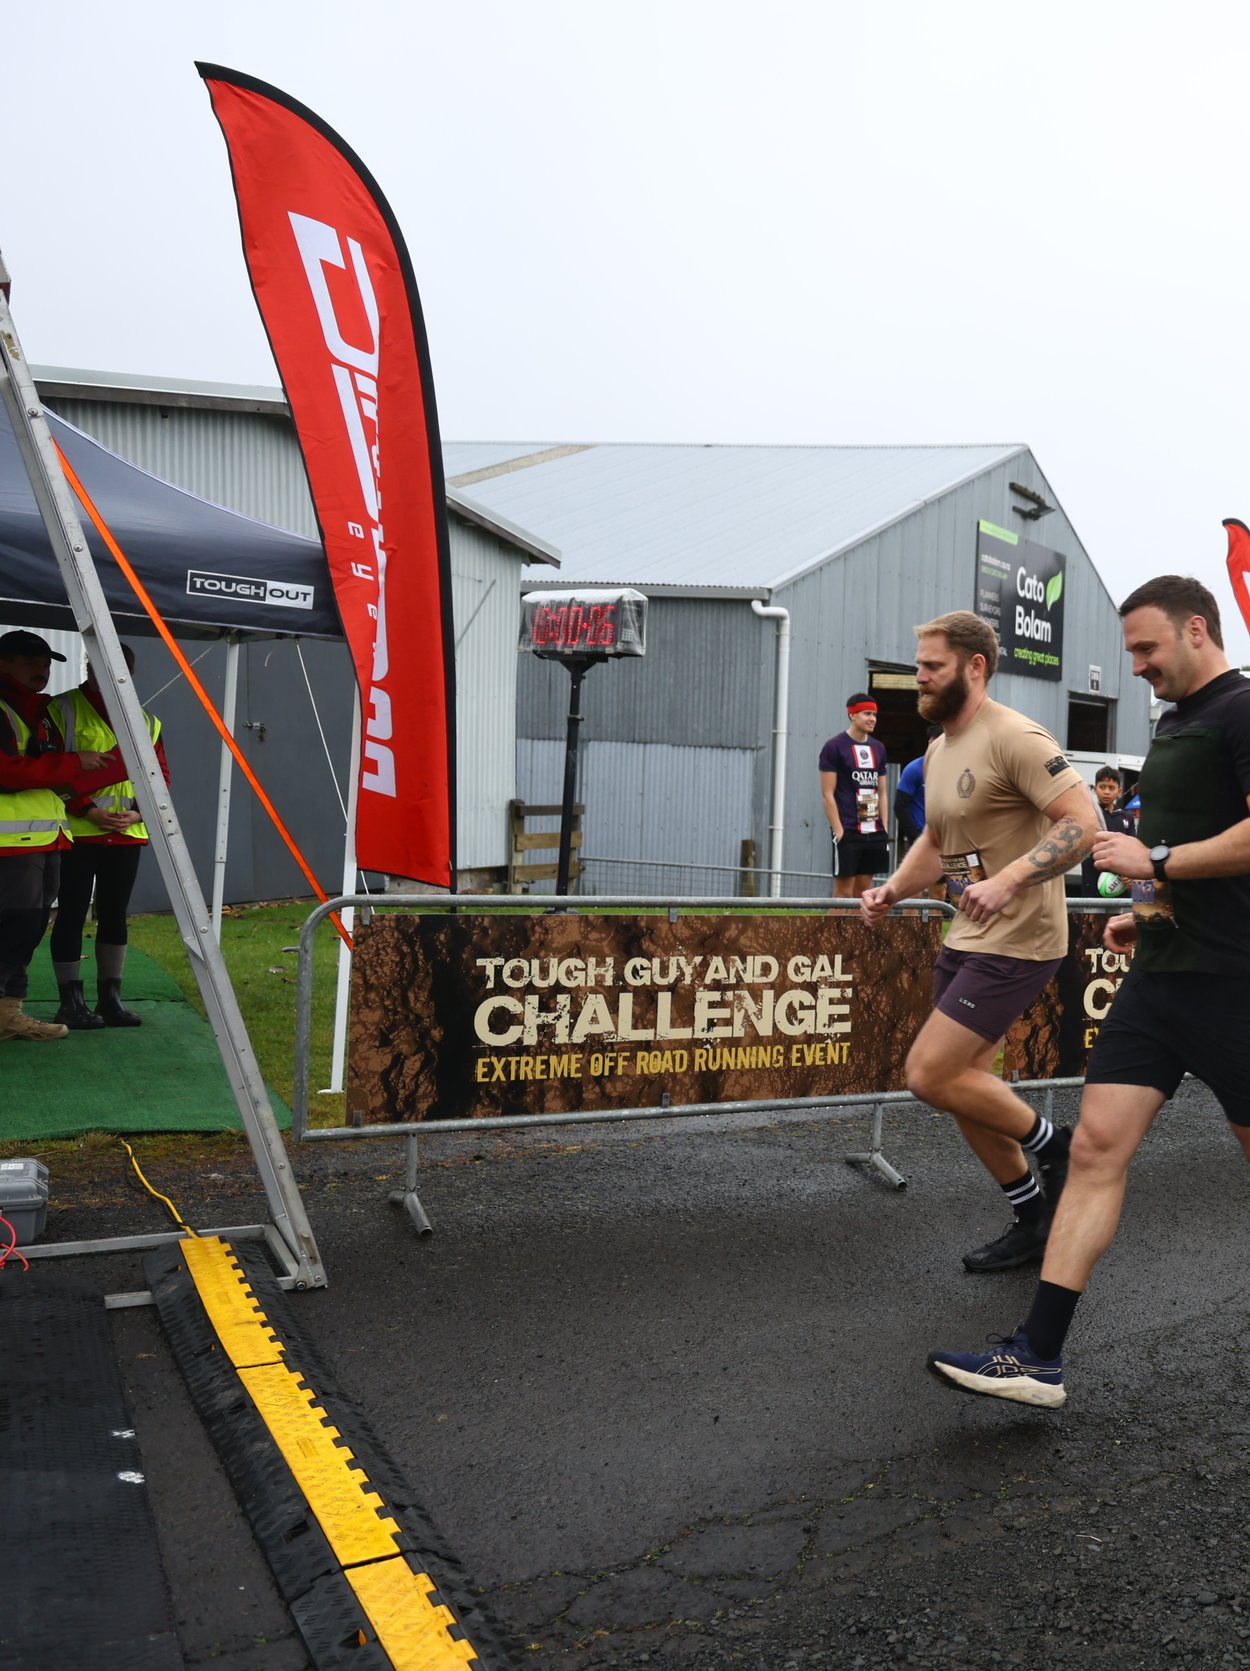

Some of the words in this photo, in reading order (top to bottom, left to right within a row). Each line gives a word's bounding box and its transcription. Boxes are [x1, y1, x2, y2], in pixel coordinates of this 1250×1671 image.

[193, 577, 265, 597] TOUGH
[269, 588, 311, 602] OUT
[1016, 566, 1045, 603] Cato
[1014, 605, 1052, 643] Bolam
[851, 770, 879, 781] QATAR
[476, 956, 614, 989] TOUGH
[624, 955, 703, 987] GUY
[704, 955, 779, 985] AND
[787, 954, 853, 983] GAL
[1085, 947, 1135, 974] TOU
[474, 987, 853, 1047] CHALLENGE
[476, 1054, 583, 1083] EXTREME
[590, 1052, 630, 1077] OFF
[636, 1050, 688, 1075] ROAD
[694, 1045, 784, 1072] RUNNING
[791, 1042, 851, 1067] EVENT
